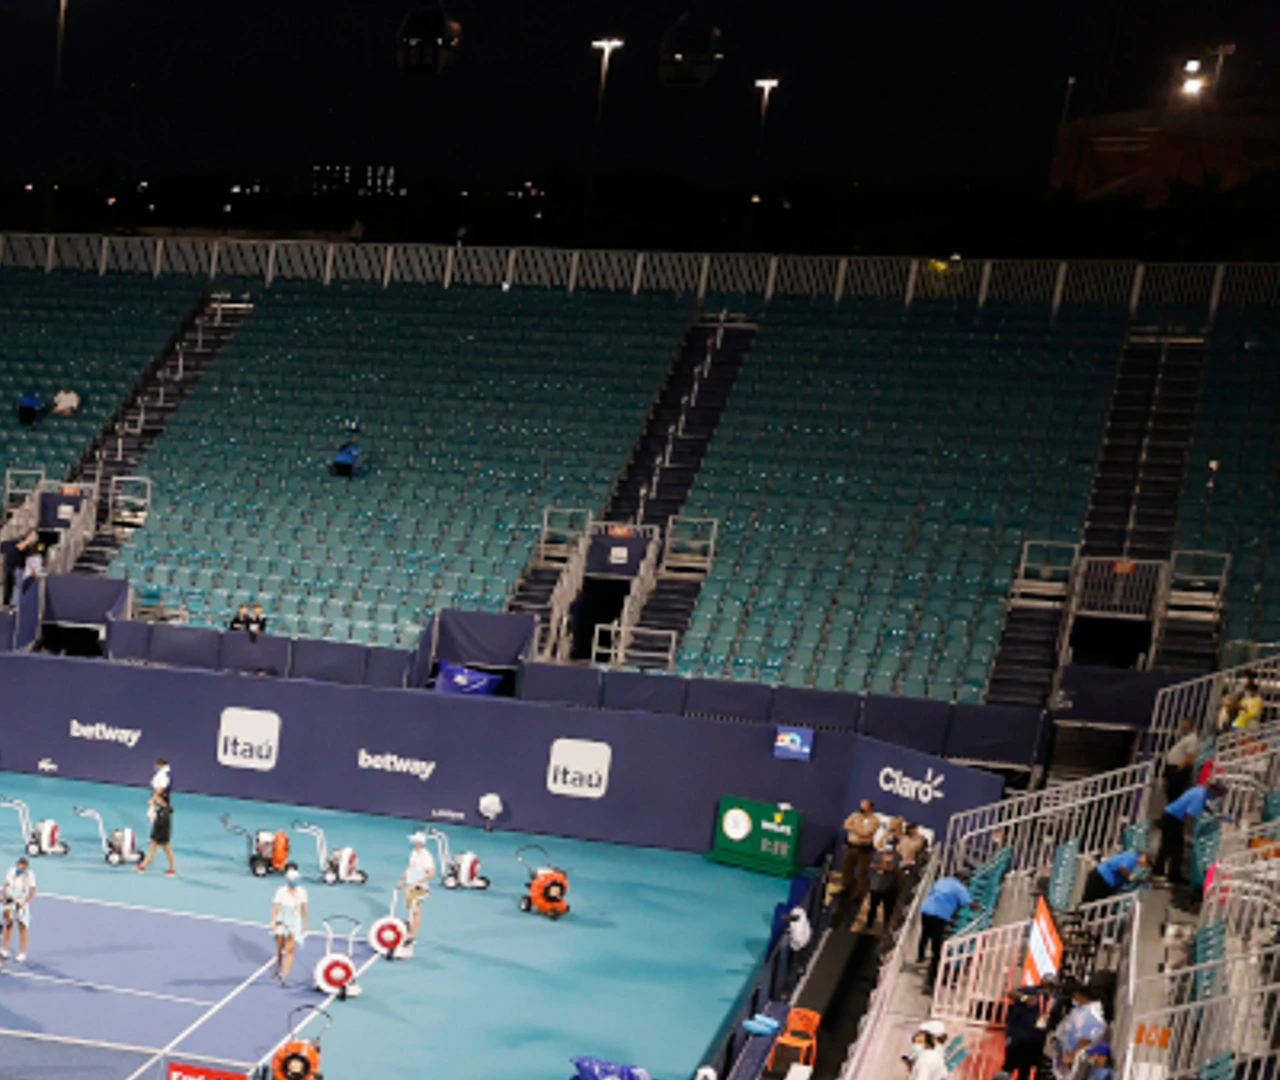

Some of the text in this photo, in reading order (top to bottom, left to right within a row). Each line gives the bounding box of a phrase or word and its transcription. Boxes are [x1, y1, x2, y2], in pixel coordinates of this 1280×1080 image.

[69, 719, 142, 747] betway
[221, 734, 274, 761] Itaú
[357, 748, 436, 781] betway
[551, 764, 603, 789] Itaú
[878, 766, 934, 804] Claro
